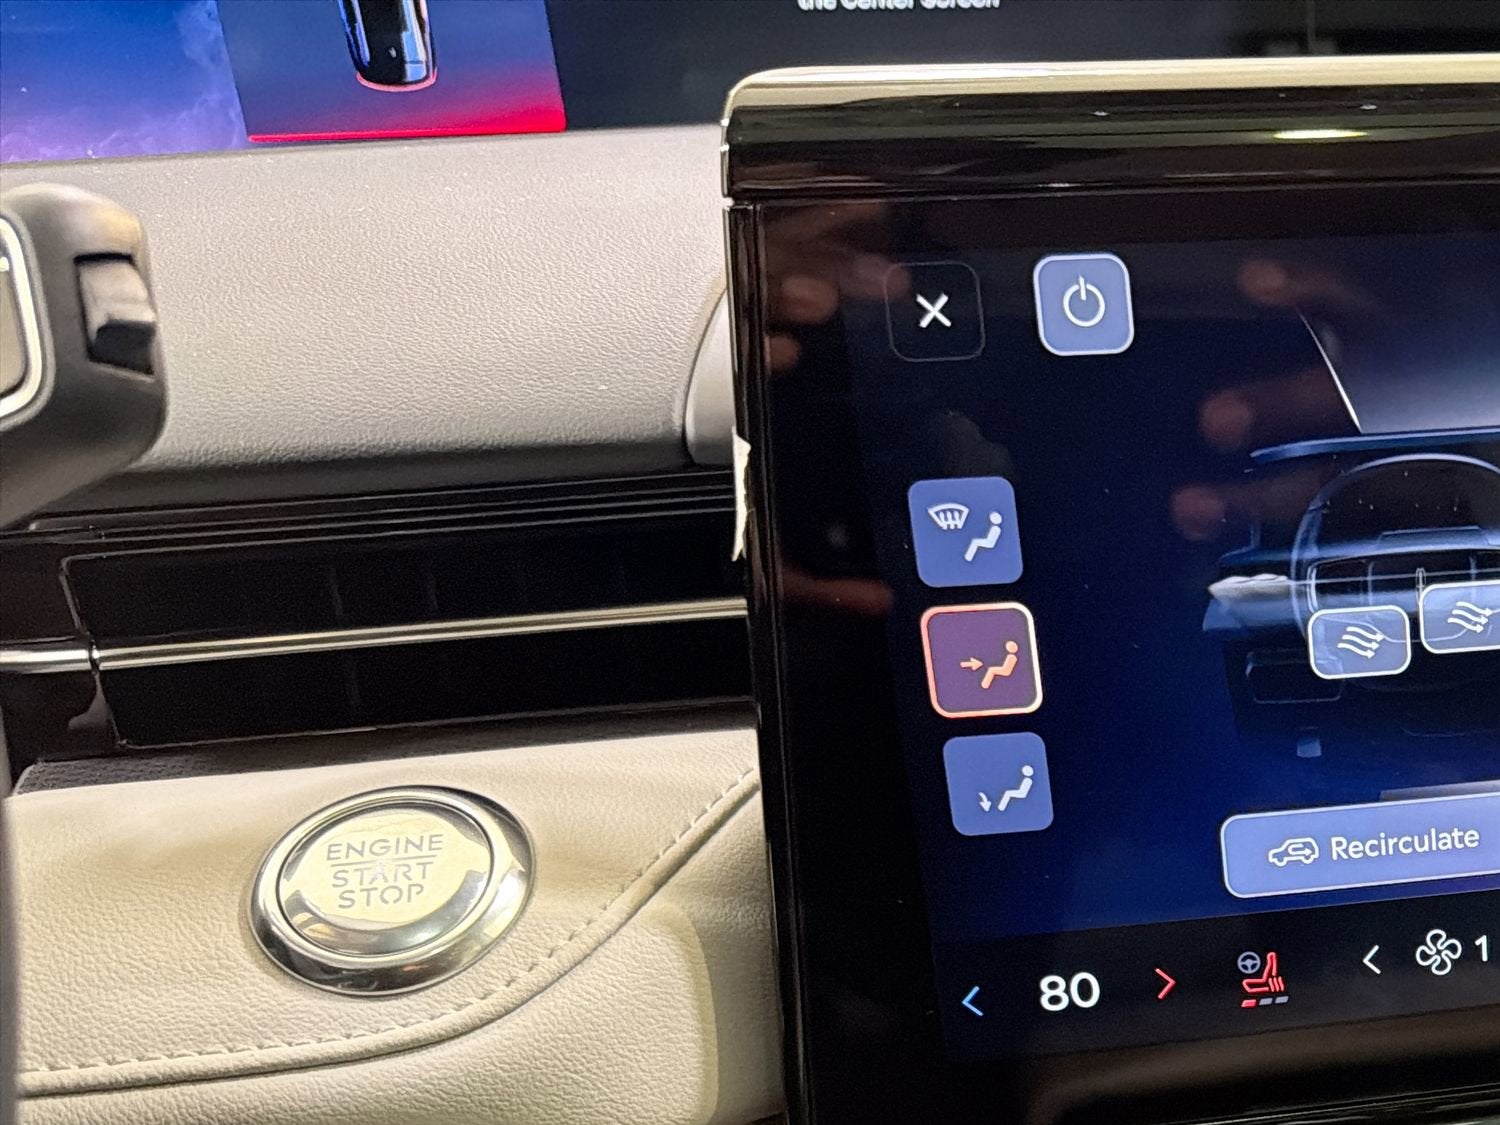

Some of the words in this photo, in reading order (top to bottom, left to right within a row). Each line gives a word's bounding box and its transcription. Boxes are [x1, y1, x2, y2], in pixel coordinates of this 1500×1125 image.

[326, 834, 444, 861] ENGINE
[1330, 828, 1480, 860] Recirculate
[332, 862, 434, 888] START
[338, 883, 425, 909] STOP
[1474, 934, 1490, 963] 1
[1039, 971, 1101, 1012] 80
